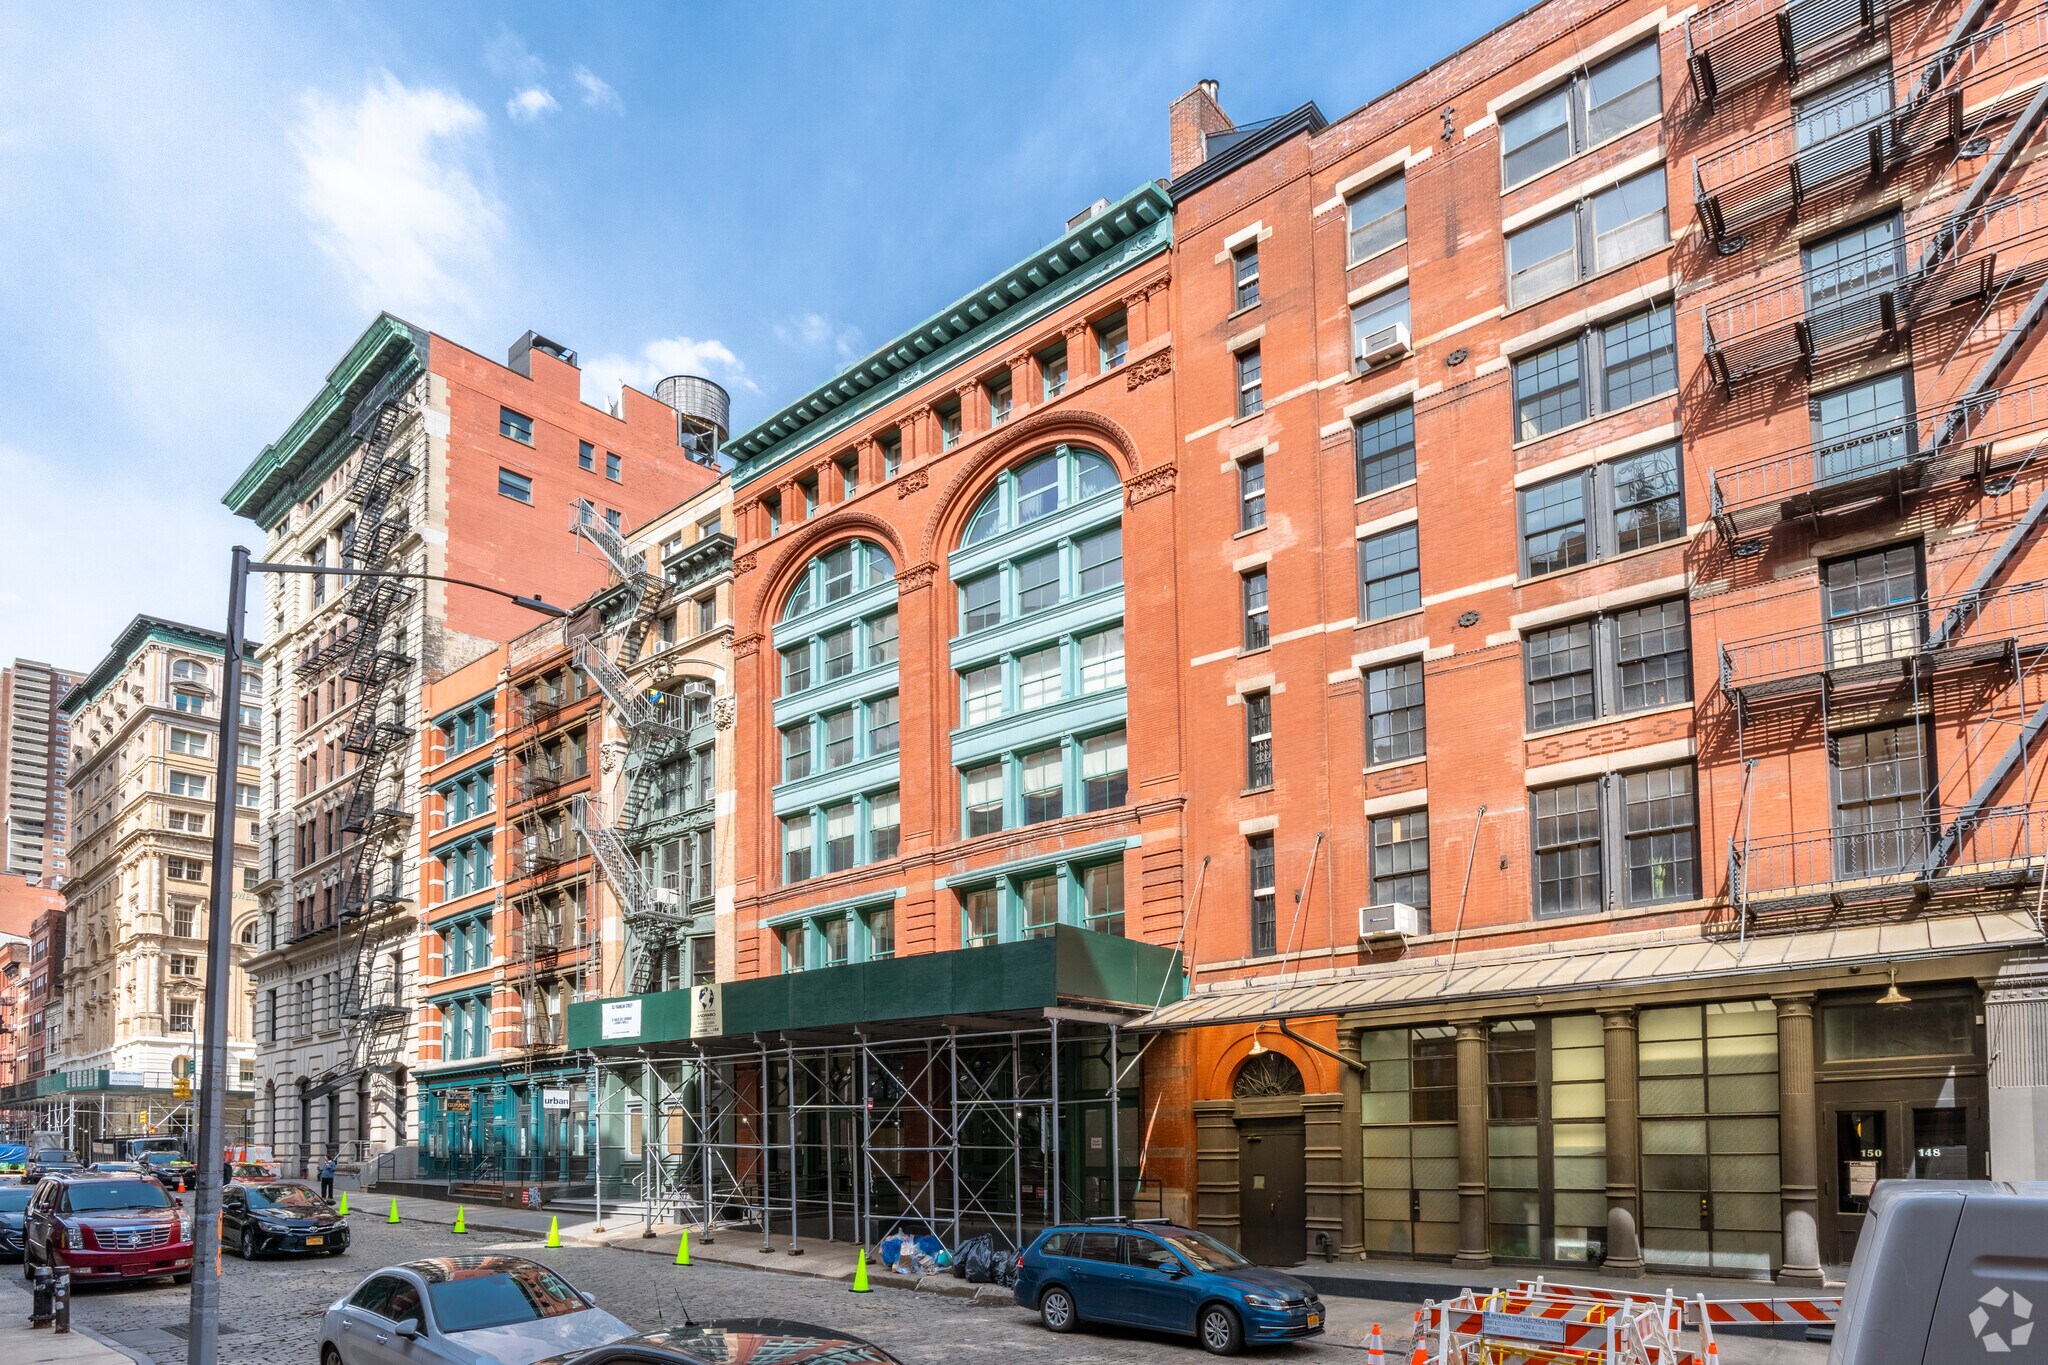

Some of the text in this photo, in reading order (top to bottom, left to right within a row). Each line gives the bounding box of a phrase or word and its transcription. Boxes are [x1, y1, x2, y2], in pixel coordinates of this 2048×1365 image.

[232, 892, 257, 901] OWEL
[544, 1096, 569, 1105] urban
[1860, 1149, 1883, 1157] 150
[1918, 1148, 1941, 1157] 148
[1491, 1313, 1512, 1321] REPAIRING
[1523, 1317, 1547, 1325] ELECTRICAL
